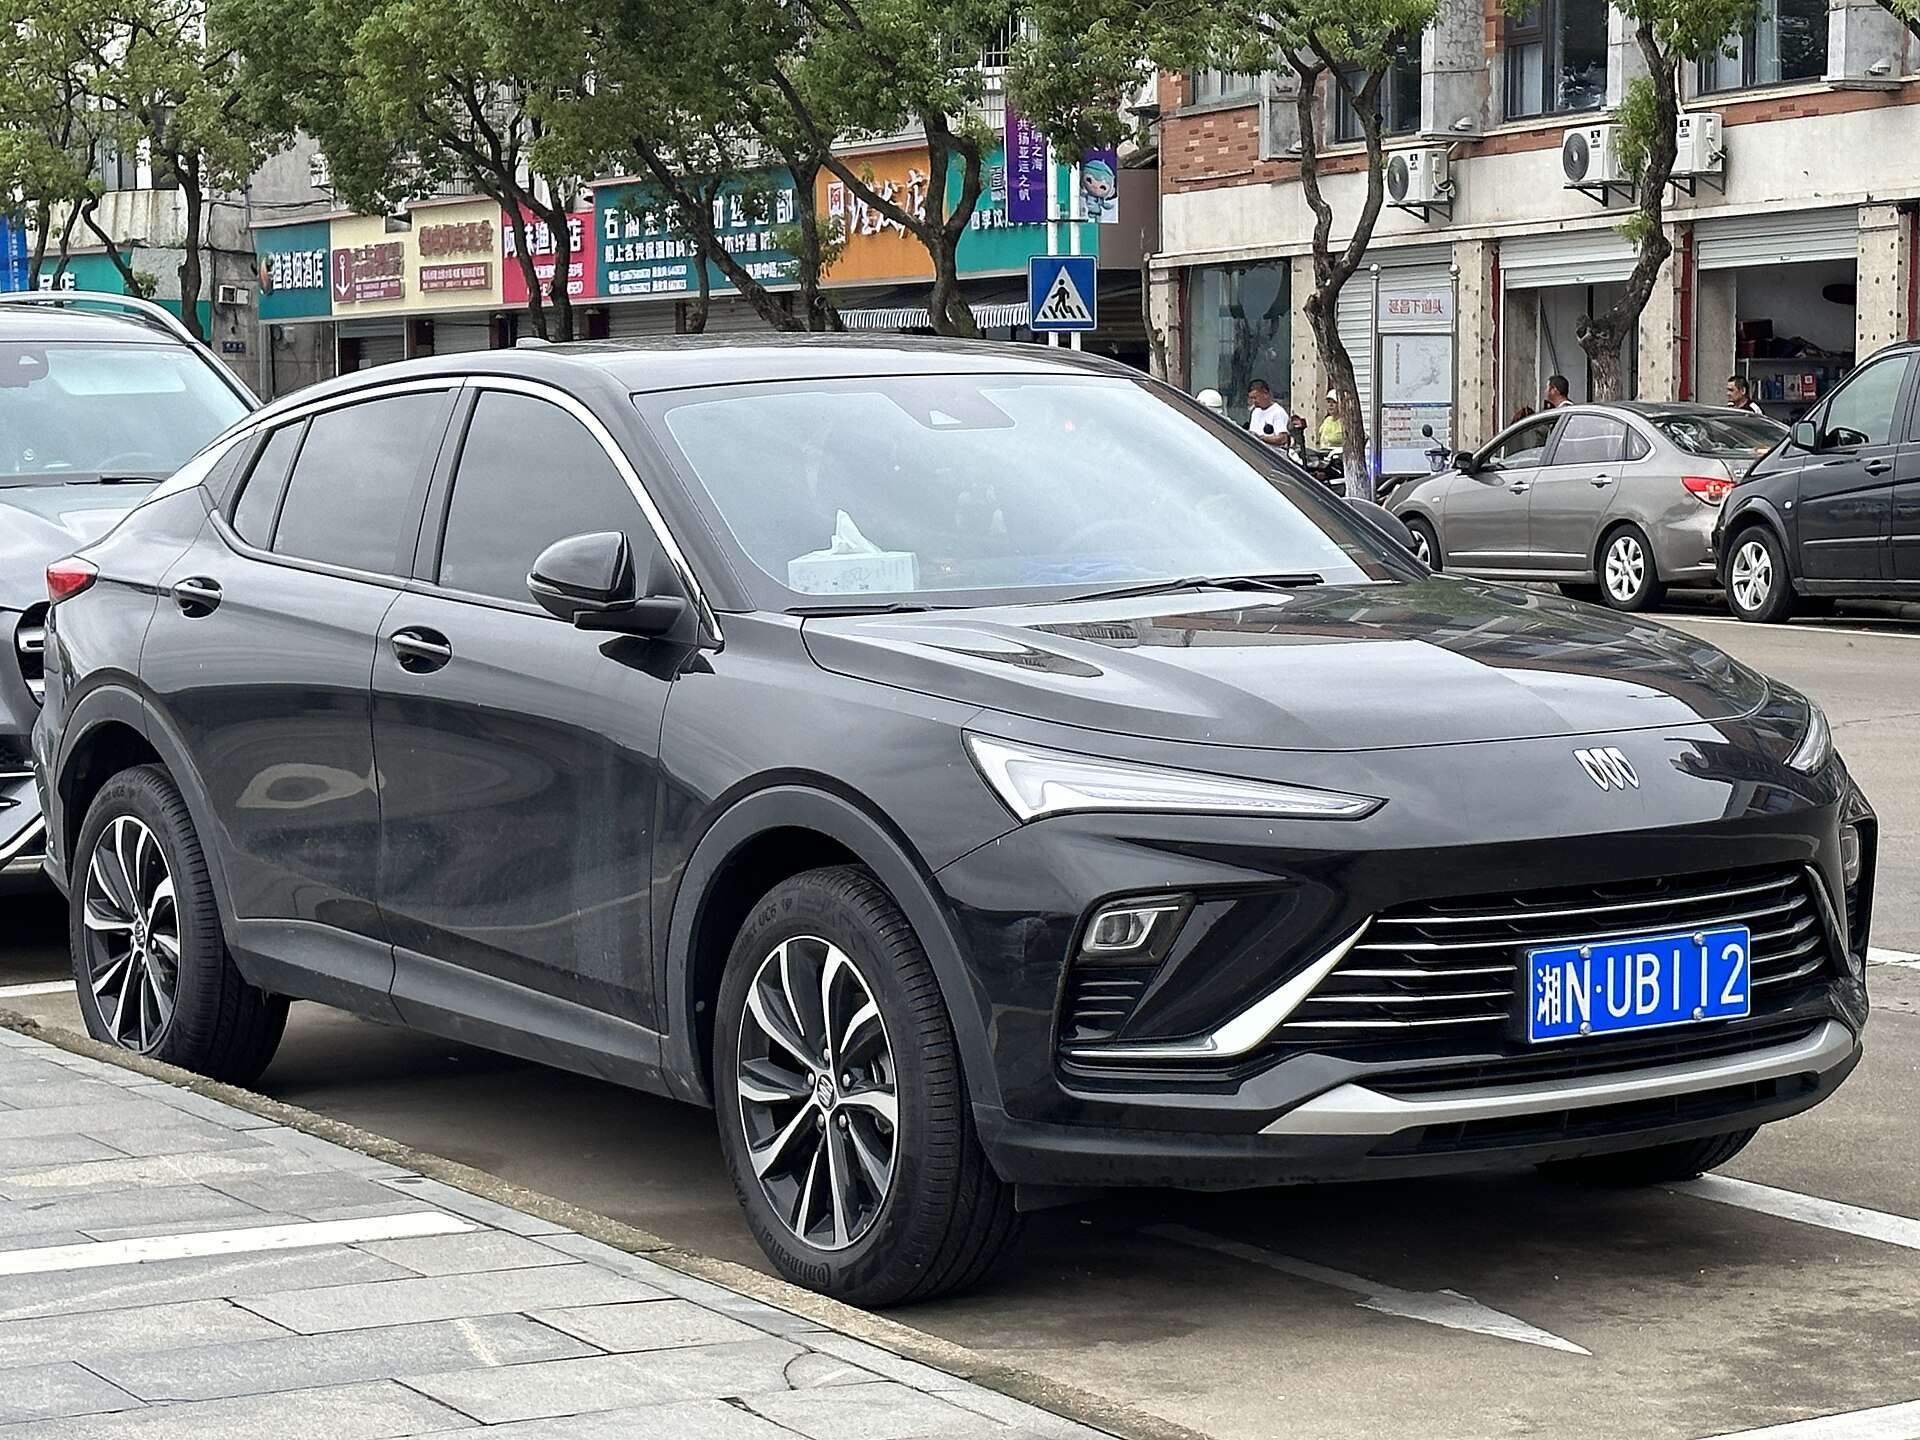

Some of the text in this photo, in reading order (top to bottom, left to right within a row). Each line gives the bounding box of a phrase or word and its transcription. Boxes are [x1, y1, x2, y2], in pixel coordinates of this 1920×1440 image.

[1031, 126, 1044, 172] 明之海
[1537, 943, 1745, 1026] 湘N·UB112
